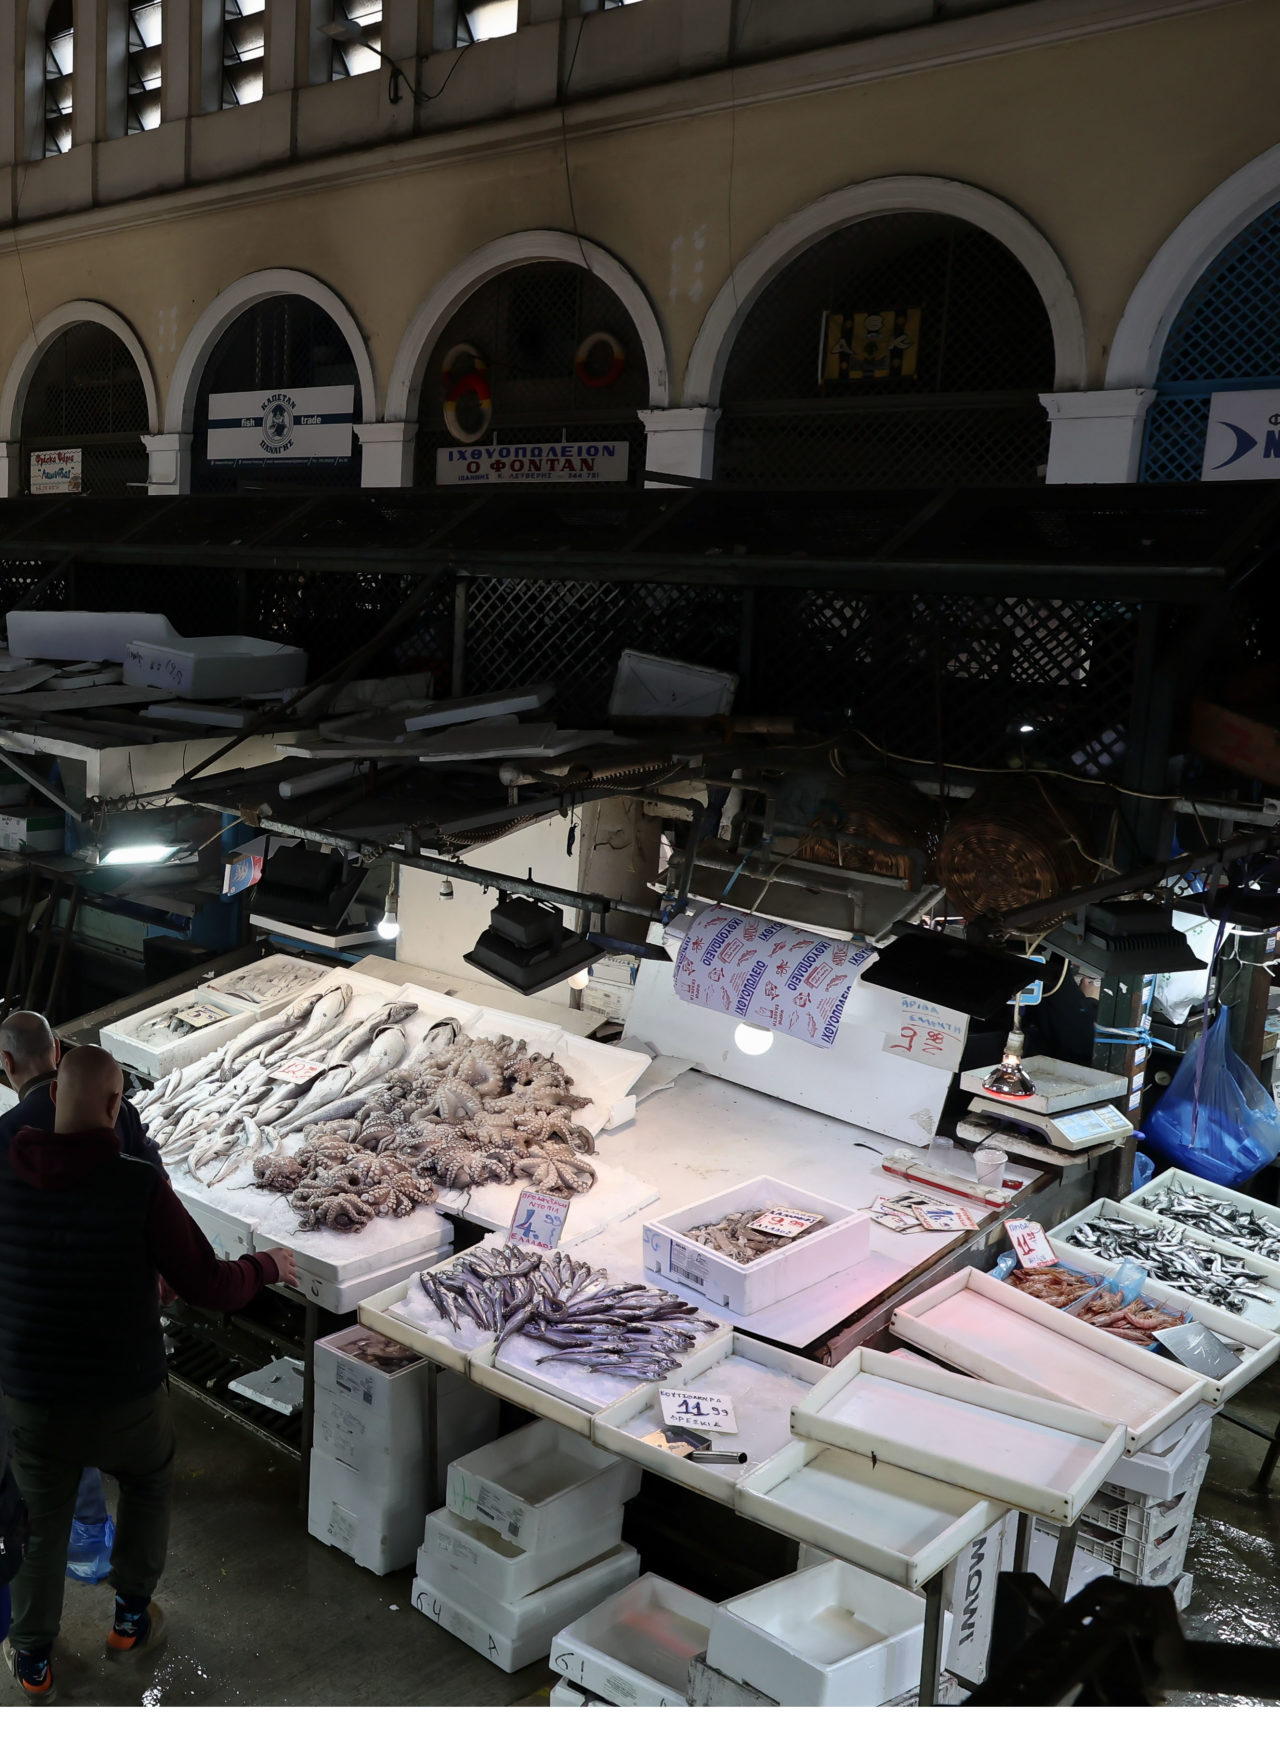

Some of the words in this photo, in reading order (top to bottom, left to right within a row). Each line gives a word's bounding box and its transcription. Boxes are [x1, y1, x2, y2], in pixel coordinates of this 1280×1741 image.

[261, 393, 297, 411] ΚΑΠΕΤΑΝ
[241, 418, 256, 427] fish
[301, 416, 322, 425] trade
[259, 439, 295, 455] ΠΑΝΑΓΗΣ
[448, 445, 616, 462] ΙΧΘΥΟΠΩΛΕΙΟΝ
[466, 461, 481, 474] Ο
[489, 458, 596, 474] ΦΟΝΤΑΝ
[702, 917, 744, 966] ΙΧΘΥΟΠΩΛΕΙΟ
[787, 941, 832, 992] ΙΧΘΥΟΠΩΛΕΙΟ
[735, 960, 766, 1016] ΙΧΘΥΟΠΩΛΕΙΟ
[676, 1399, 710, 1417] 11
